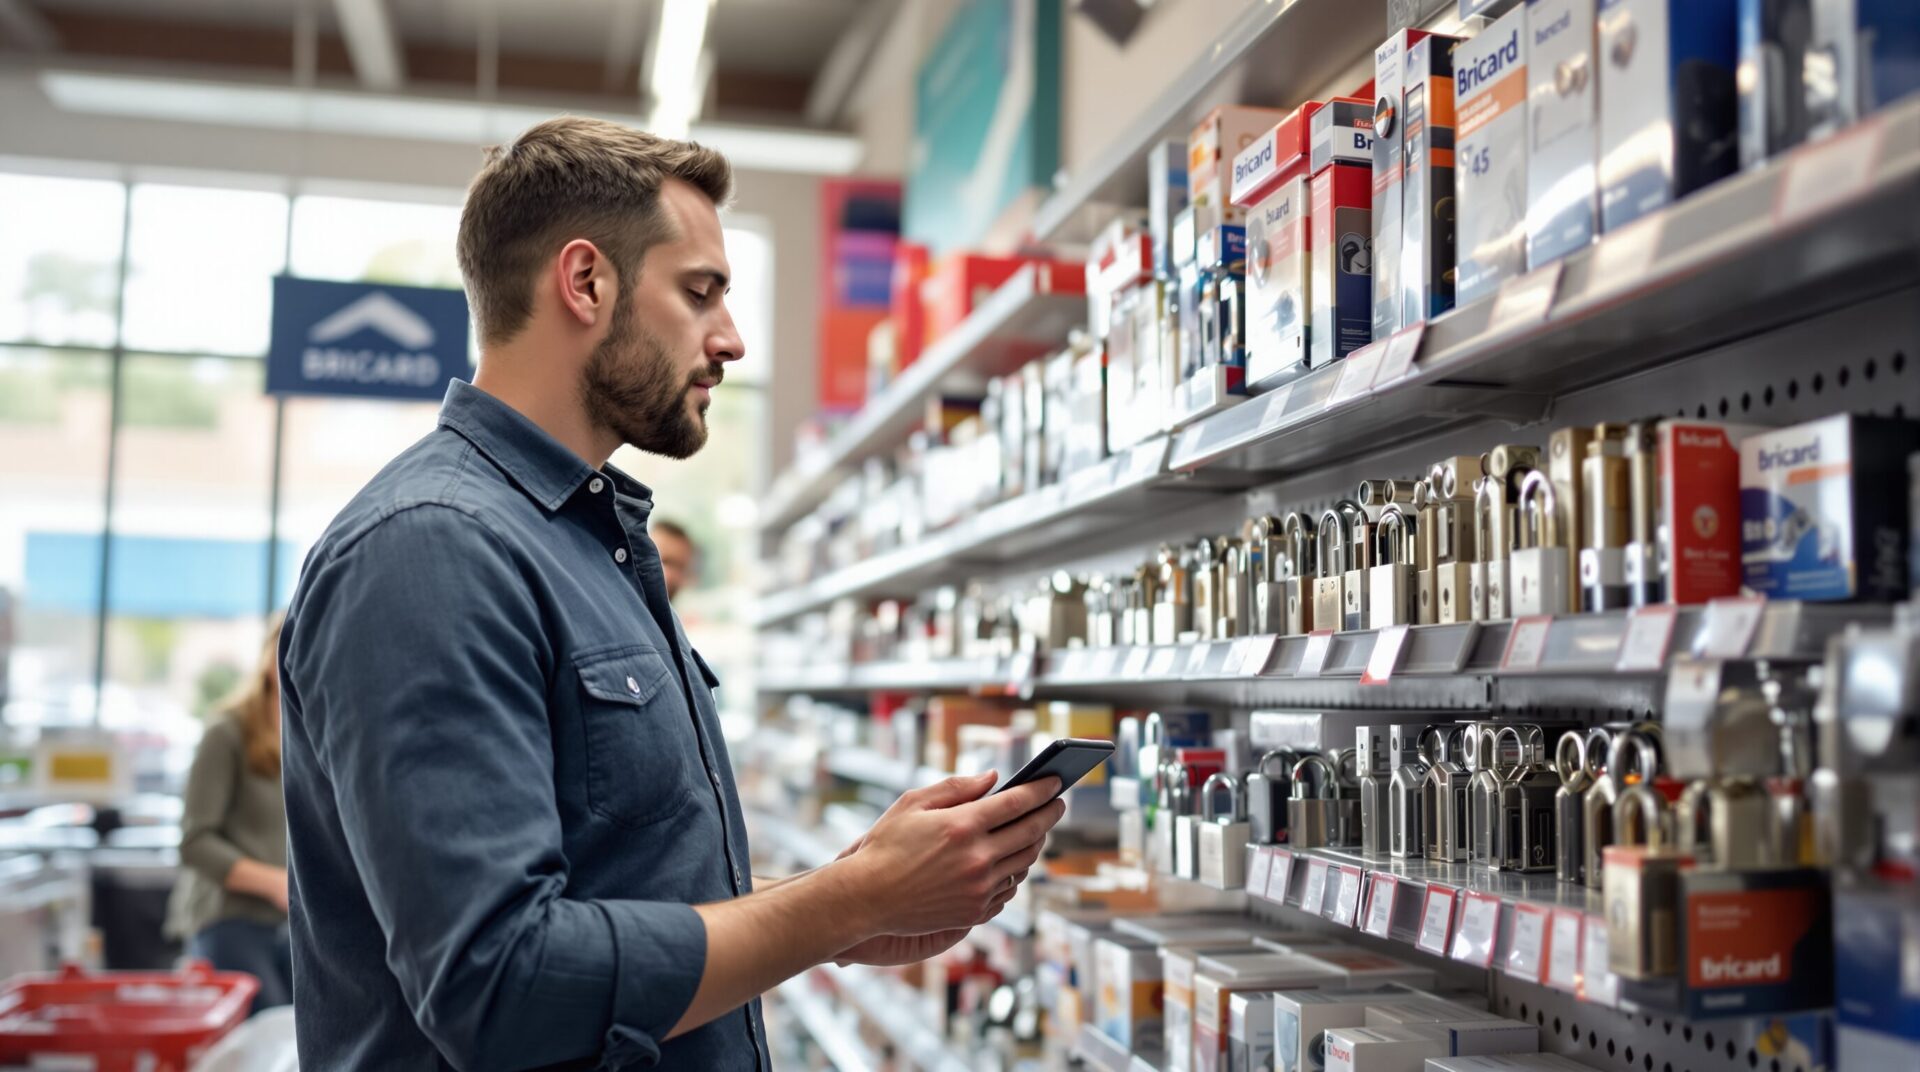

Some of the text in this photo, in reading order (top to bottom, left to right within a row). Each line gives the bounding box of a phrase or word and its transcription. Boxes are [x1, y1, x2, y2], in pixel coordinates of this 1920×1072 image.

[1458, 29, 1518, 97] Bricard
[1236, 139, 1272, 184] Bricard
[1472, 146, 1490, 177] 45
[302, 347, 440, 388] BRICARD
[1758, 434, 1821, 472] bricard
[1700, 953, 1780, 982] bricard
